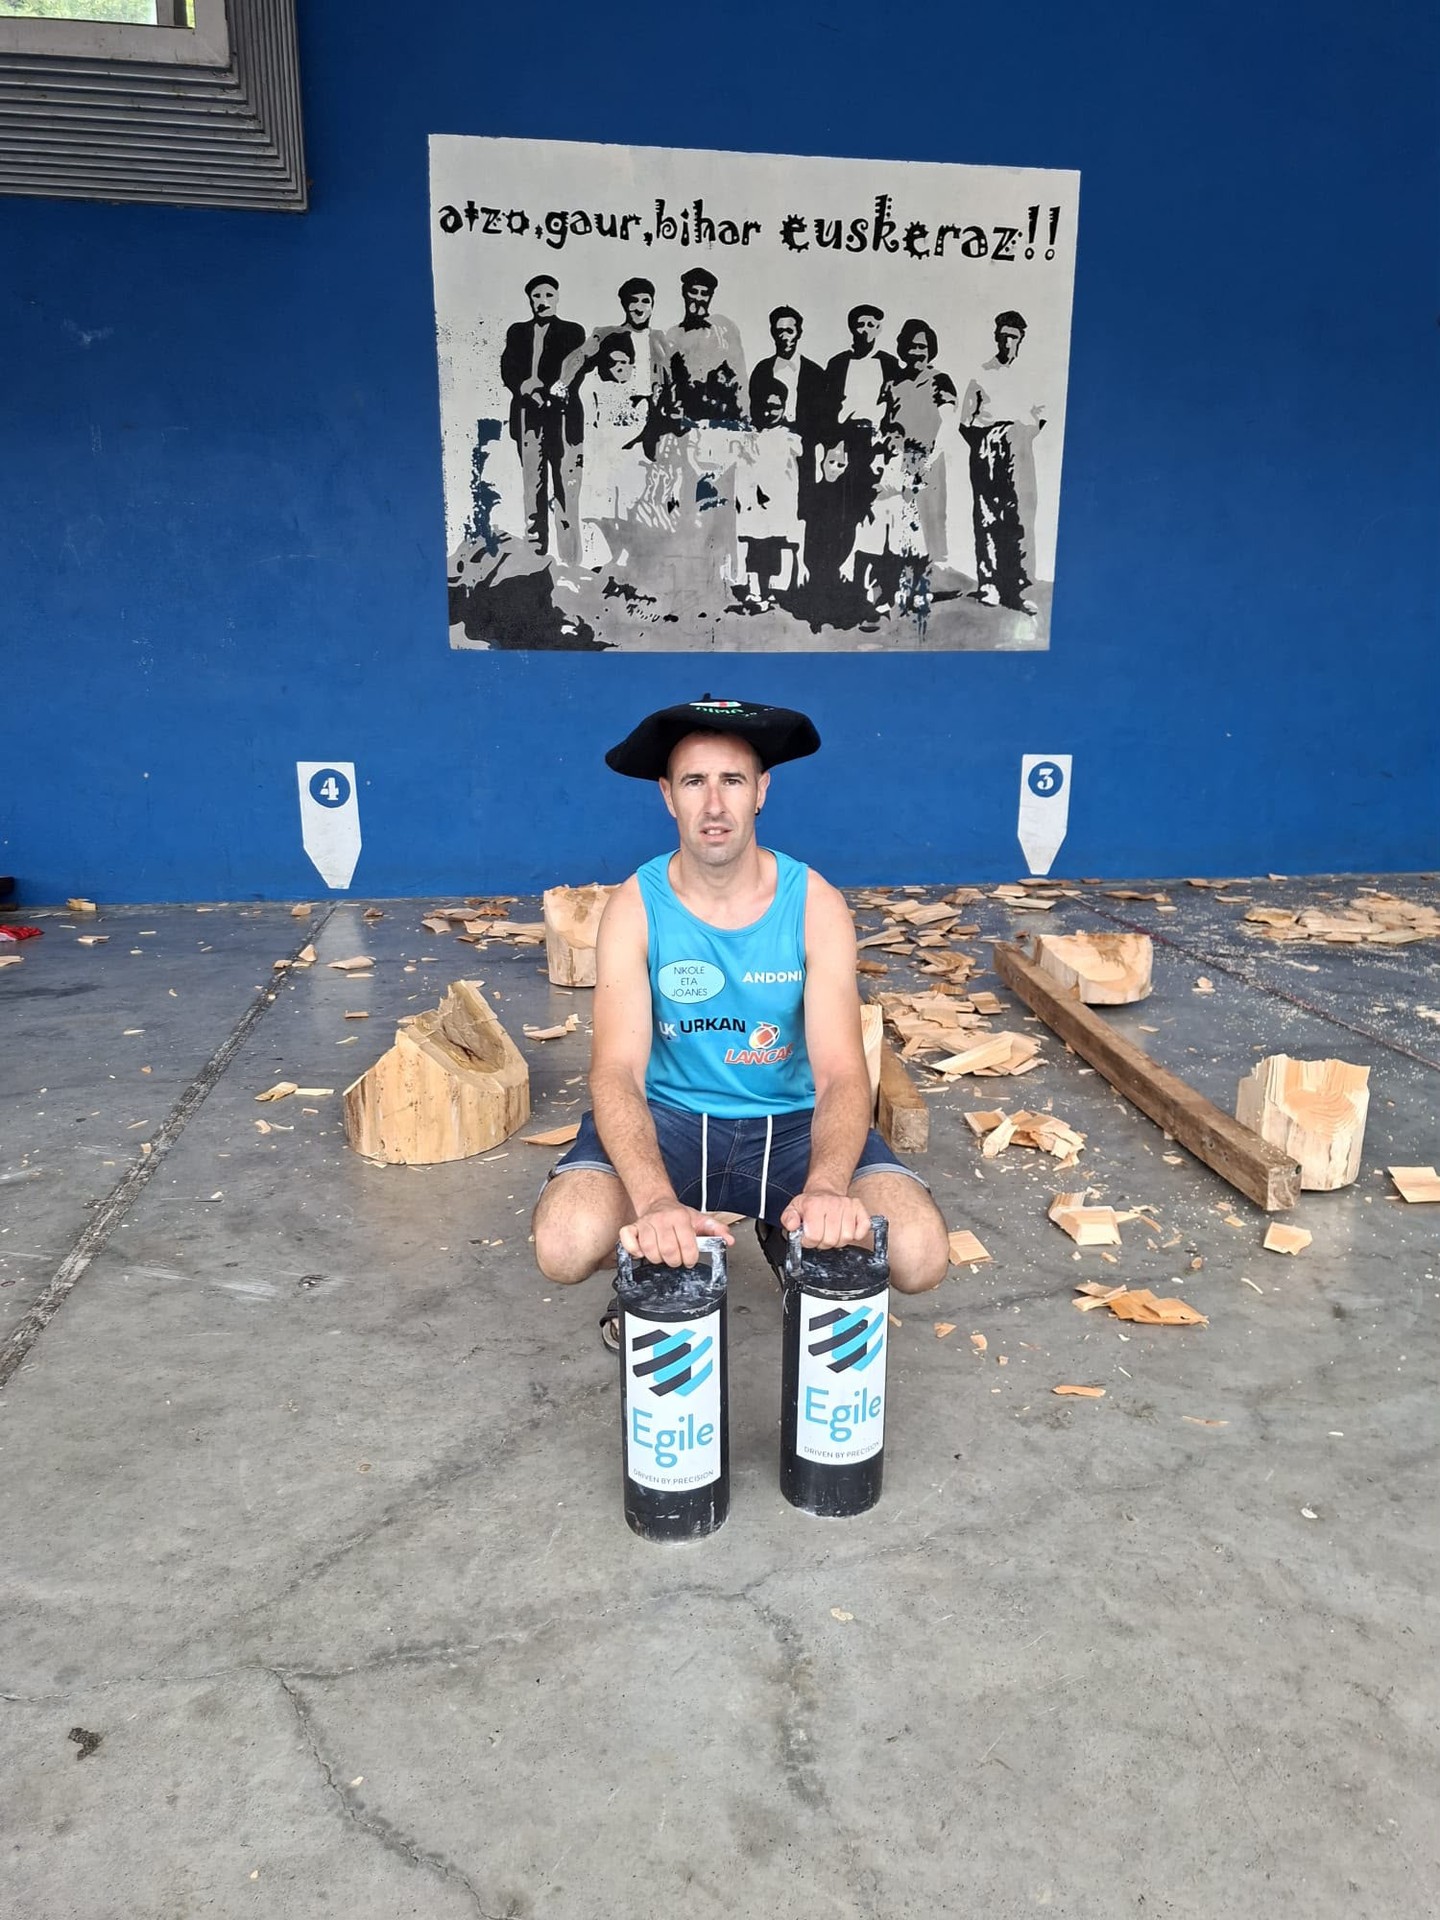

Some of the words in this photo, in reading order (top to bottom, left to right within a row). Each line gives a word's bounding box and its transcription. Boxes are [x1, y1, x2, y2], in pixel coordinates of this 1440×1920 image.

[779, 194, 1061, 262] euskeraz!!
[1037, 768, 1054, 790] 3
[320, 777, 339, 800] 4
[673, 966, 705, 975] NIKOLE
[742, 970, 802, 983] ANDONI
[680, 977, 698, 986] ETA
[671, 988, 708, 997] JOANES
[680, 1017, 746, 1034] URKAN
[804, 1385, 882, 1443] Egile
[632, 1406, 714, 1468] Egile
[803, 1446, 833, 1459] DRIVEN
[633, 1468, 660, 1483] DRIVEN
[661, 1477, 671, 1485] BY
[672, 1469, 714, 1485] PRECISION
